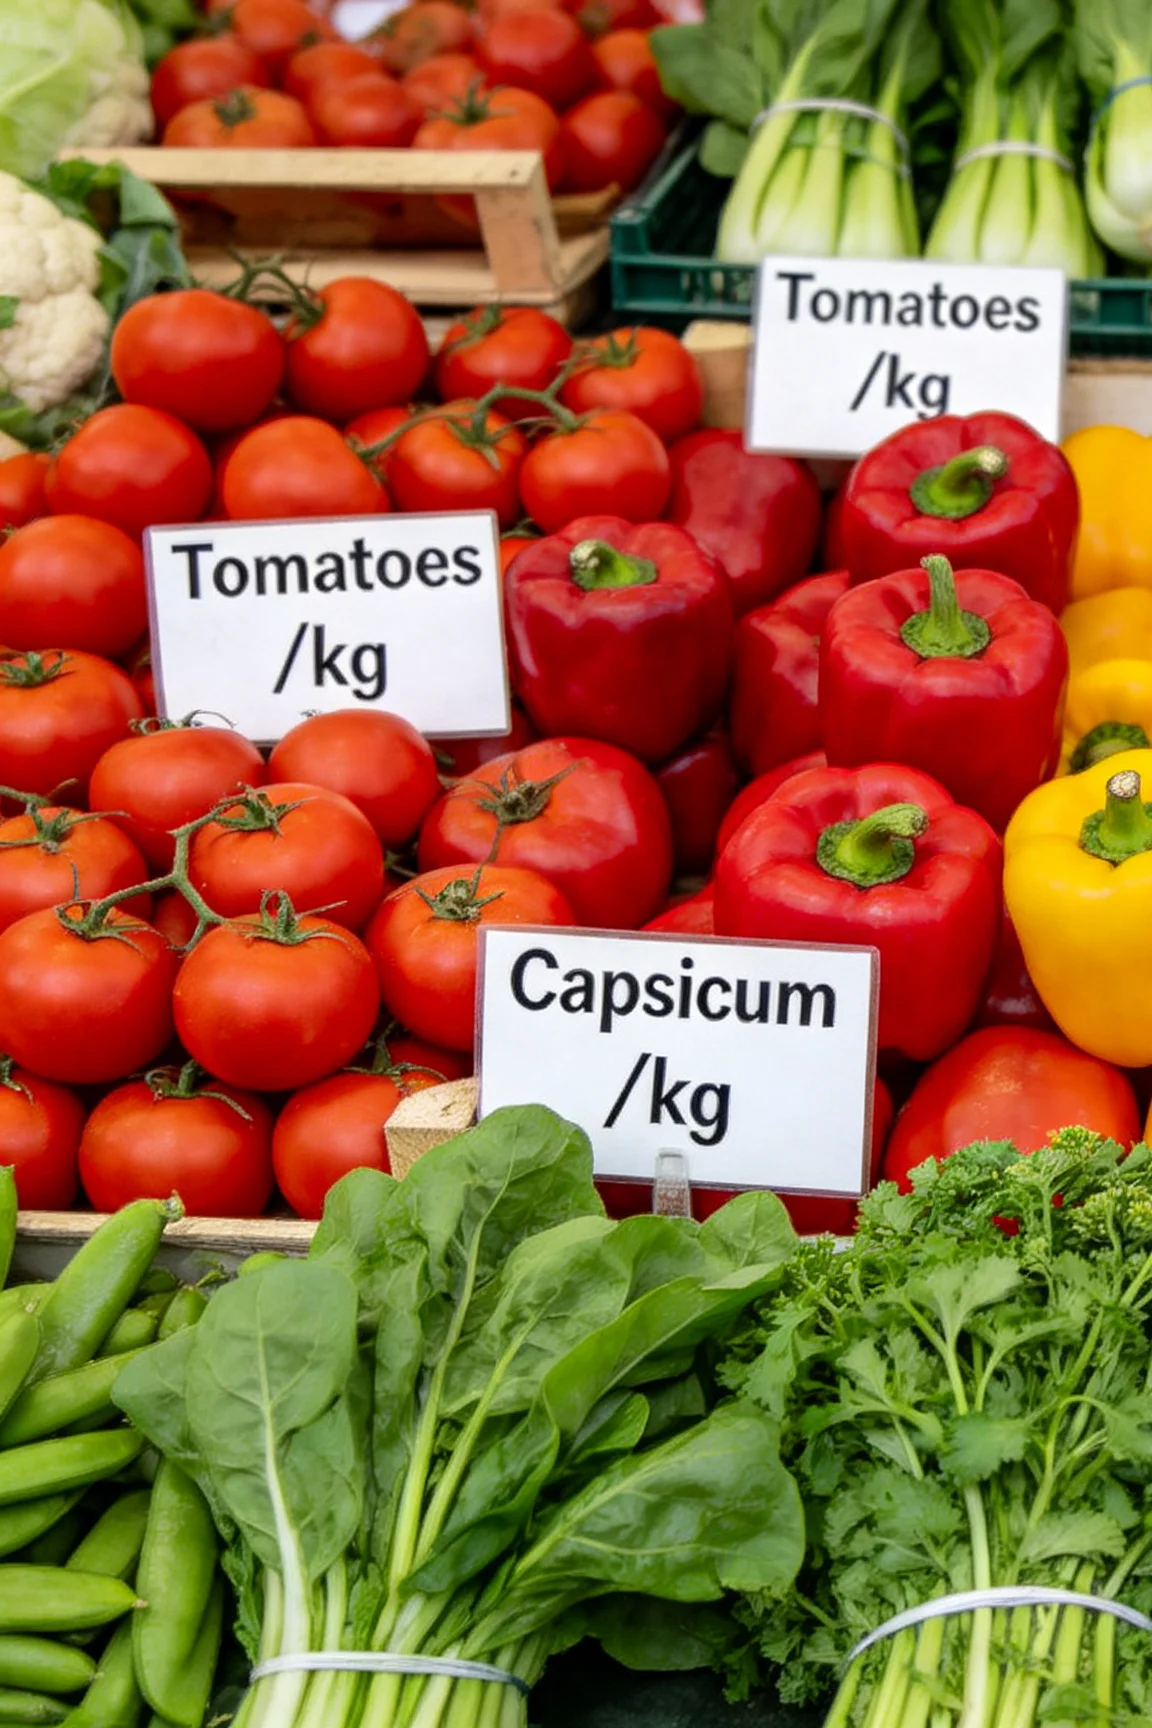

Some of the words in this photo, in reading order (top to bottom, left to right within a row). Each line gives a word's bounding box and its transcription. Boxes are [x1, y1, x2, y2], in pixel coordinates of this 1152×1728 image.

[777, 272, 1040, 332] Tomatoes
[850, 351, 950, 419] /kg
[171, 538, 482, 599] Tomatoes
[273, 622, 387, 700] /kg
[510, 948, 836, 1034] Capsicum
[602, 1052, 731, 1147] /kg
